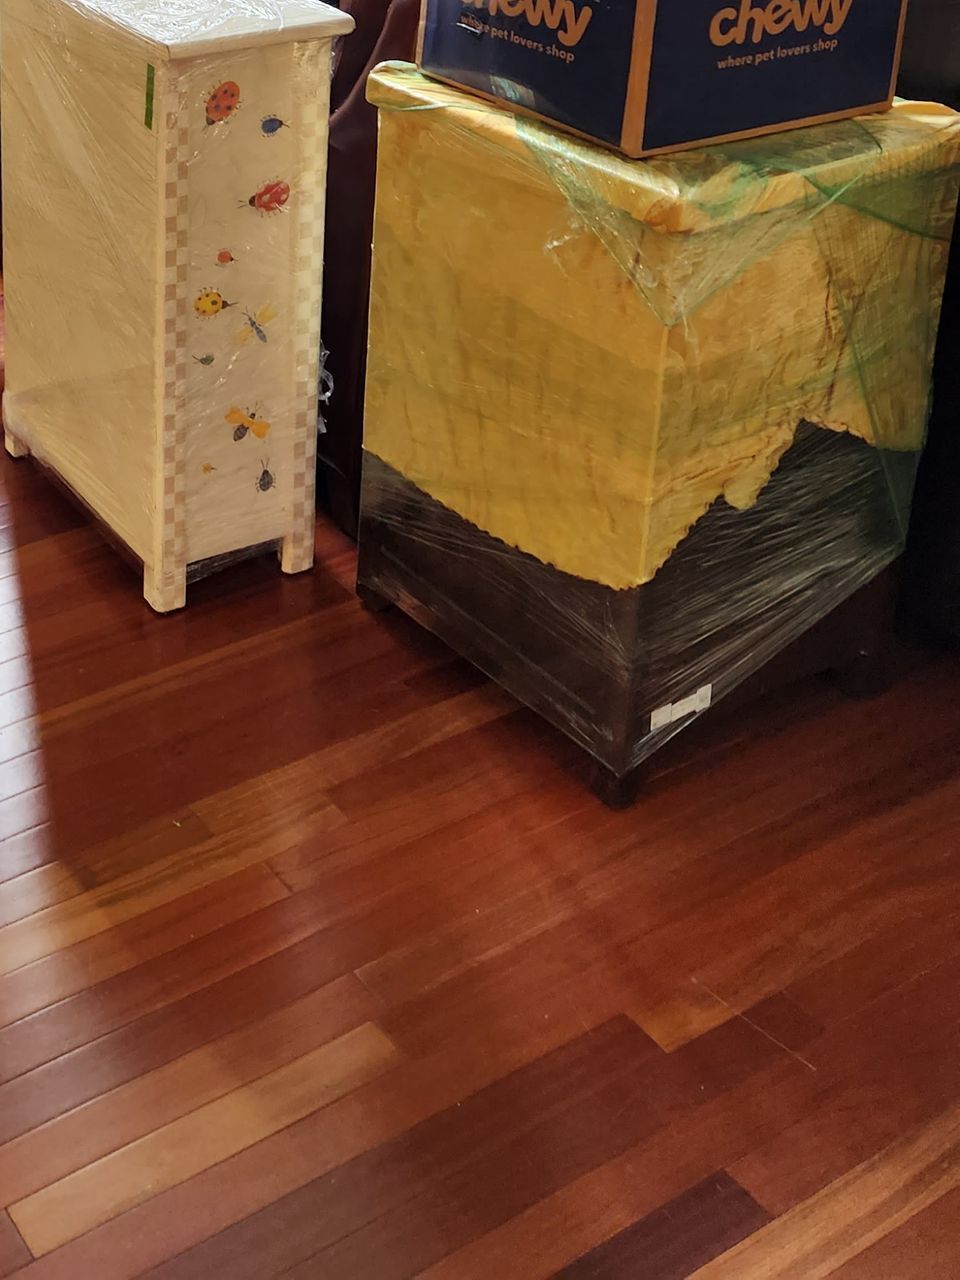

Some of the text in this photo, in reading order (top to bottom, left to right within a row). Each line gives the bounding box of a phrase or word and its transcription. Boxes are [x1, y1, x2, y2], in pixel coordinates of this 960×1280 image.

[491, 26, 509, 41] pet
[510, 30, 544, 53] lovers
[545, 44, 575, 64] shop
[717, 38, 838, 69] where pet lovers shop
